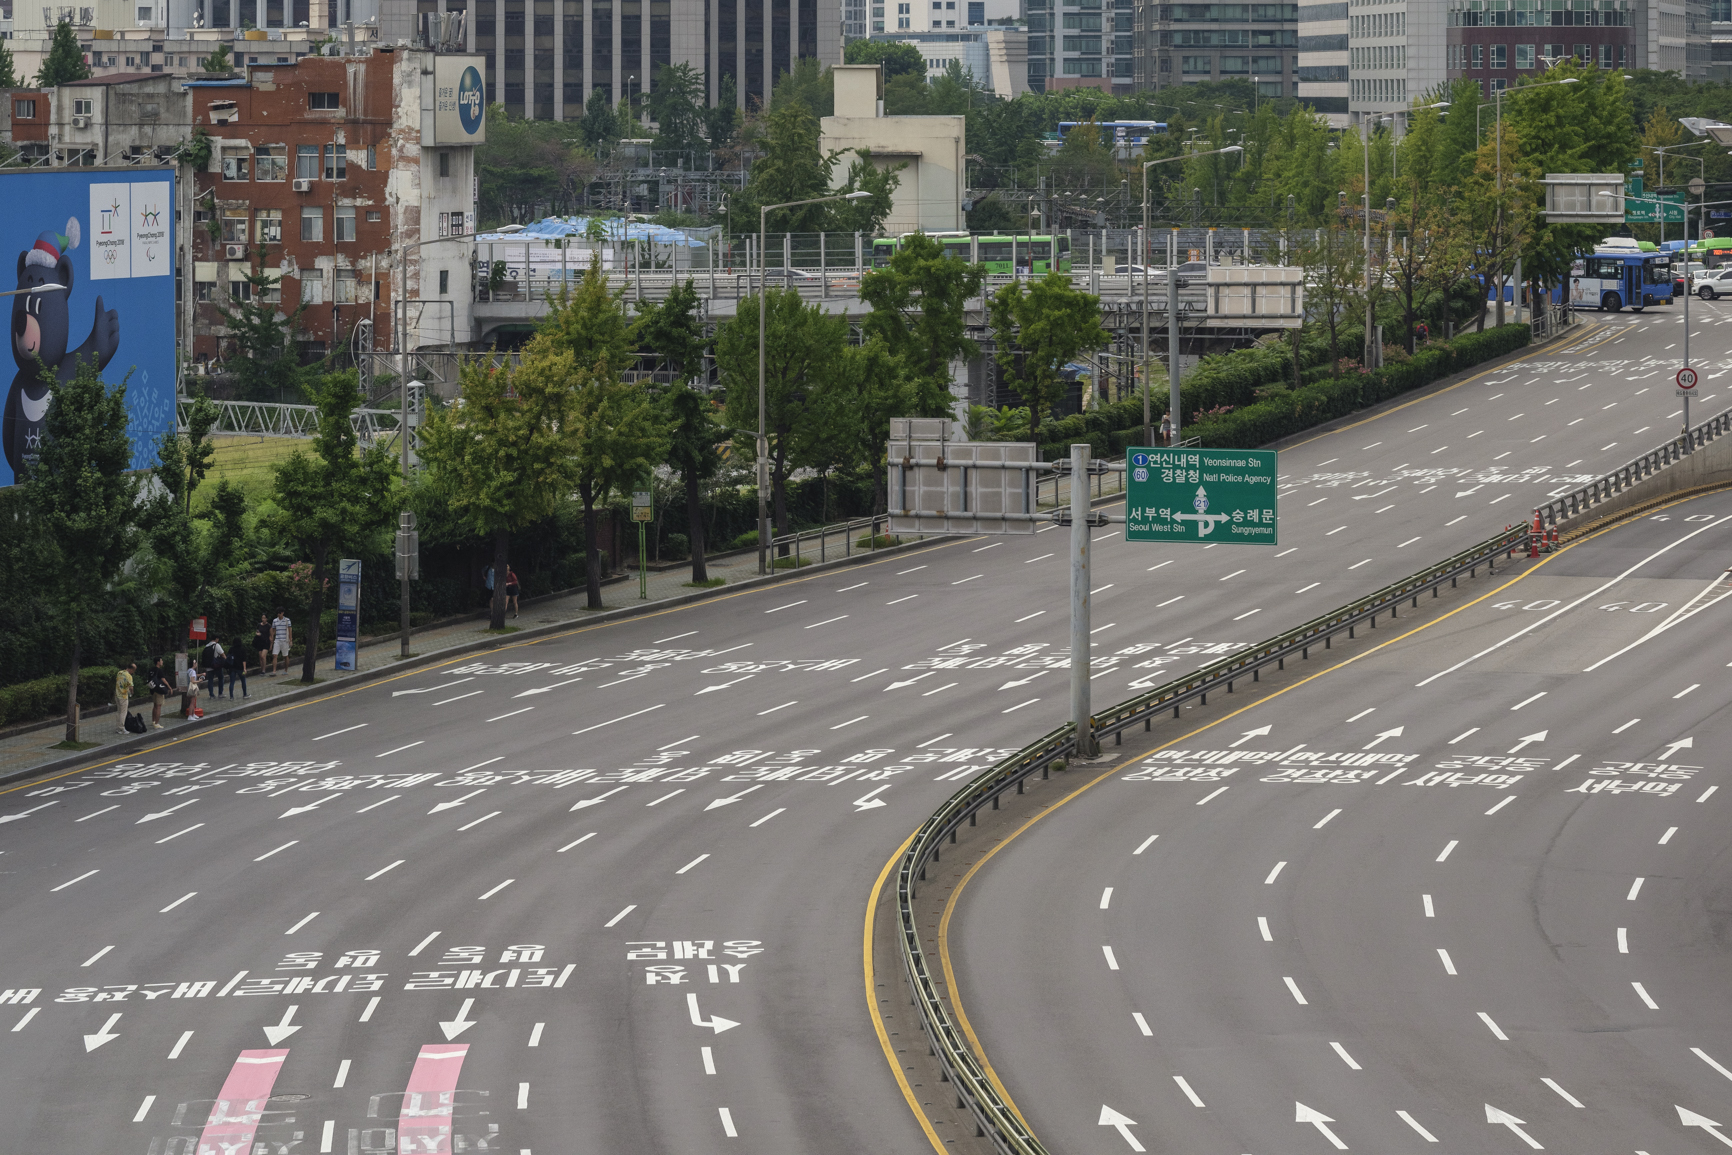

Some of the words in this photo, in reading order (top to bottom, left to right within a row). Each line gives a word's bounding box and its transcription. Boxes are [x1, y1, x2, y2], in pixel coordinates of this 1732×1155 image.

[460, 91, 480, 104] LOTTO
[1681, 374, 1693, 383] 40
[1149, 453, 1200, 468] 연신내역
[1203, 457, 1246, 467] Yeonsinnae
[1248, 458, 1261, 468] Stn
[1136, 470, 1146, 480] 60
[1161, 469, 1200, 484] 경찰청
[1220, 474, 1242, 483] Police
[1244, 474, 1271, 484] Agency
[1197, 499, 1207, 507] 21
[1130, 506, 1171, 521] 서부역
[1231, 508, 1275, 524] 숭례문
[1649, 514, 1715, 522] 40
[1130, 522, 1149, 531] Seoul
[1151, 523, 1171, 532] West
[1173, 524, 1185, 532] Stn
[1231, 525, 1273, 535] Sungnyemun
[1491, 599, 1561, 611] 40
[1598, 601, 1669, 613] 40
[701, 658, 861, 674] 버스전용
[1142, 750, 1282, 765] 연신내역
[1279, 752, 1420, 767] 연신내역
[1434, 755, 1551, 772] 공덕동
[585, 766, 723, 784] 퇴계로
[720, 765, 857, 782] 퇴계로
[1121, 766, 1241, 782] 경찰청
[1259, 768, 1379, 784] 경찰청
[1588, 760, 1704, 780] 공덕동
[299, 772, 443, 791] 버스전용
[435, 769, 597, 788] 버스전용
[1401, 771, 1525, 789] 서부역
[1563, 778, 1684, 797] 서부역
[437, 944, 546, 965] 명동
[625, 940, 765, 960] 숭례문
[275, 949, 381, 970] 명동
[404, 967, 558, 990] 퇴계로
[645, 963, 747, 985] 시청
[54, 981, 217, 1003] 버스전용
[233, 973, 388, 996] 퇴계로
